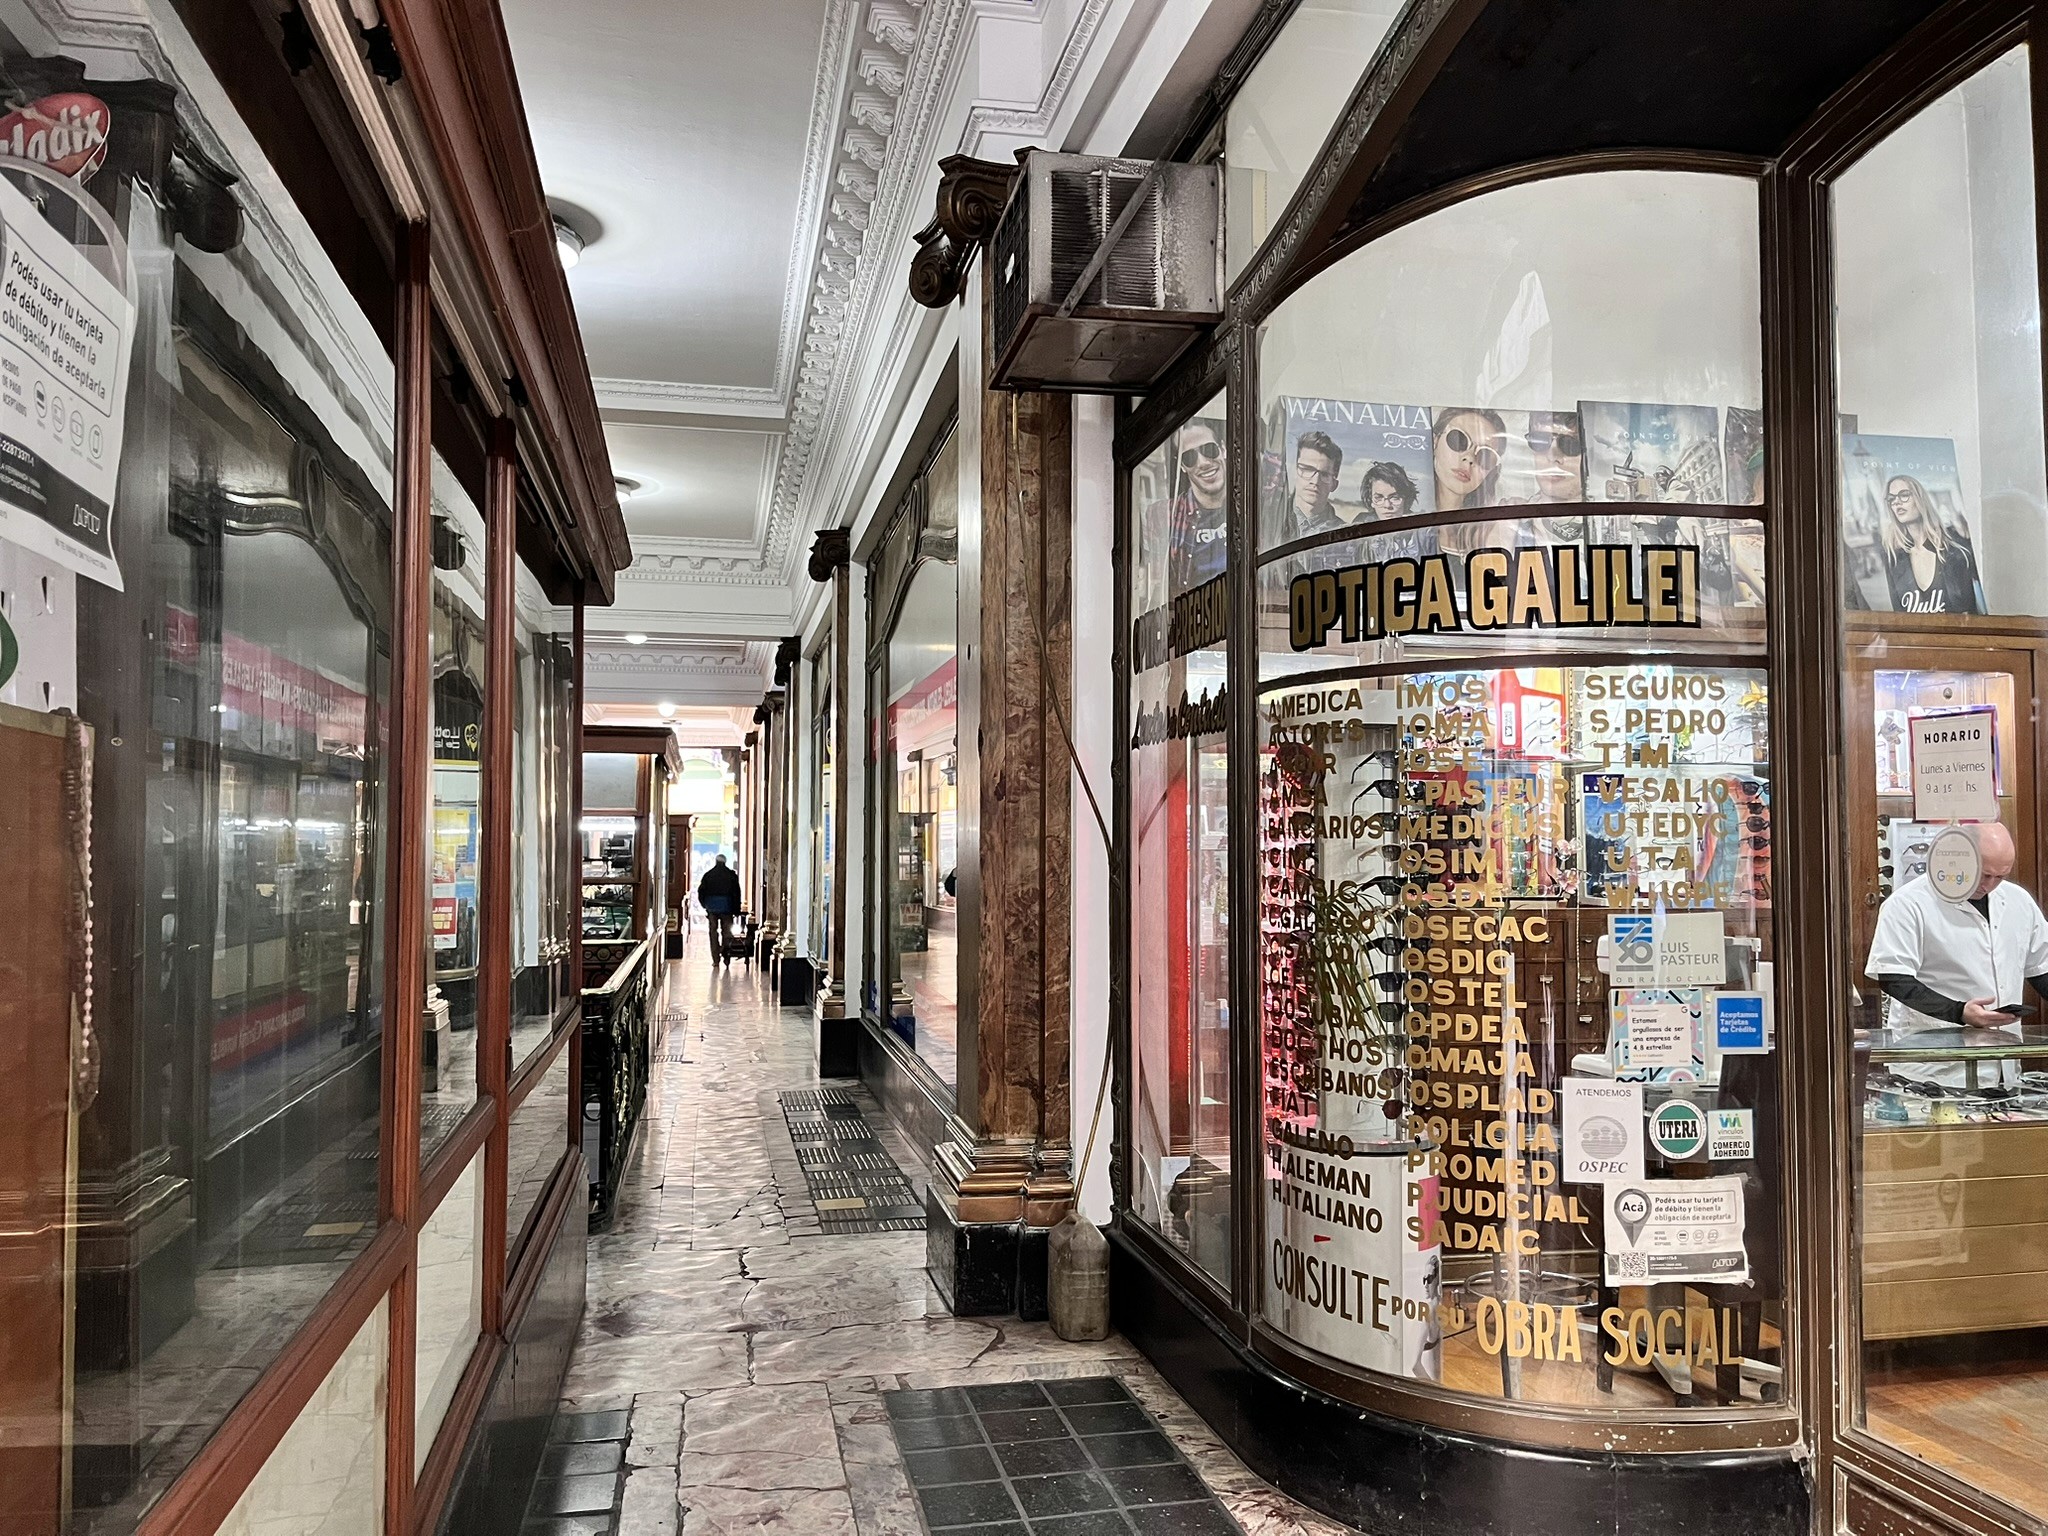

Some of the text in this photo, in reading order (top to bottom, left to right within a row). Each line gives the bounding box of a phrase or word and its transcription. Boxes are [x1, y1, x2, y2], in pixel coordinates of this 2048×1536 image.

[0, 104, 103, 163] ladix
[11, 250, 104, 344] Podés usar tu tarjeta
[5, 279, 97, 366] de débito y tienen la
[2, 309, 106, 400] obligación de aceptarla
[1285, 396, 1432, 430] WANAMA
[1289, 544, 1701, 653] OPTICA GALILEI
[1397, 680, 1487, 709] IMOS
[1584, 674, 1726, 701] SEGUROS
[1397, 710, 1491, 739] IOMA
[1589, 708, 1726, 735] S.PEDRO
[1924, 728, 1981, 744] HORARIO
[1593, 743, 1669, 768] TIM
[1920, 763, 1943, 775] Lunes
[1953, 761, 1986, 773] Viernes
[1598, 778, 1730, 805] VESALIO
[1925, 784, 1931, 794] 9
[1269, 815, 1384, 840] BANCARIOS
[1400, 812, 1562, 841] MEDICUS
[1603, 812, 1728, 838] UTEDYC
[1400, 848, 1498, 875] OSIM
[1937, 870, 1970, 886] Google
[1401, 882, 1505, 909] OSDE
[1404, 915, 1549, 943] OSECAC
[1404, 947, 1512, 976] OSDIC
[1660, 942, 1689, 954] LUIS
[1660, 953, 1719, 966] PASTEUR
[1666, 975, 1720, 983] SOCIAL
[1404, 979, 1527, 1009] OSTEL
[1405, 1010, 1528, 1044] OPDEA
[1720, 1012, 1758, 1020] Aceptamos
[1720, 1019, 1749, 1027] Tarjetas
[1730, 1025, 1756, 1033] Crédito
[1632, 1026, 1662, 1035] orgullosos
[1407, 1044, 1536, 1078] OMAJA
[1270, 1058, 1392, 1099] ESCRIBANOS
[1410, 1079, 1555, 1114] OSPLAD
[1575, 1088, 1632, 1097] ATENDEMOS
[1271, 1118, 1354, 1160] GALENO
[1407, 1114, 1557, 1152] POLICIA
[1658, 1120, 1698, 1139] UTERA
[1713, 1141, 1750, 1149] COMERCIO
[1714, 1149, 1750, 1158] ADHERIDO
[1272, 1149, 1371, 1199] H.ALEMAN
[1407, 1149, 1556, 1187] PROMED
[1579, 1160, 1628, 1174] OSPEC
[1622, 1201, 1644, 1212] Acá
[1655, 1196, 1676, 1204] Podés
[1703, 1196, 1724, 1204] tarjeta
[1654, 1214, 1691, 1223] obligación
[1701, 1213, 1731, 1222] aceptarla
[1406, 1216, 1541, 1255] SADAIC
[1273, 1238, 1390, 1332] CONSULTE
[1391, 1295, 1430, 1323] POR
[1476, 1296, 1582, 1363] OBRA
[1600, 1307, 1744, 1366] SOCIAL
